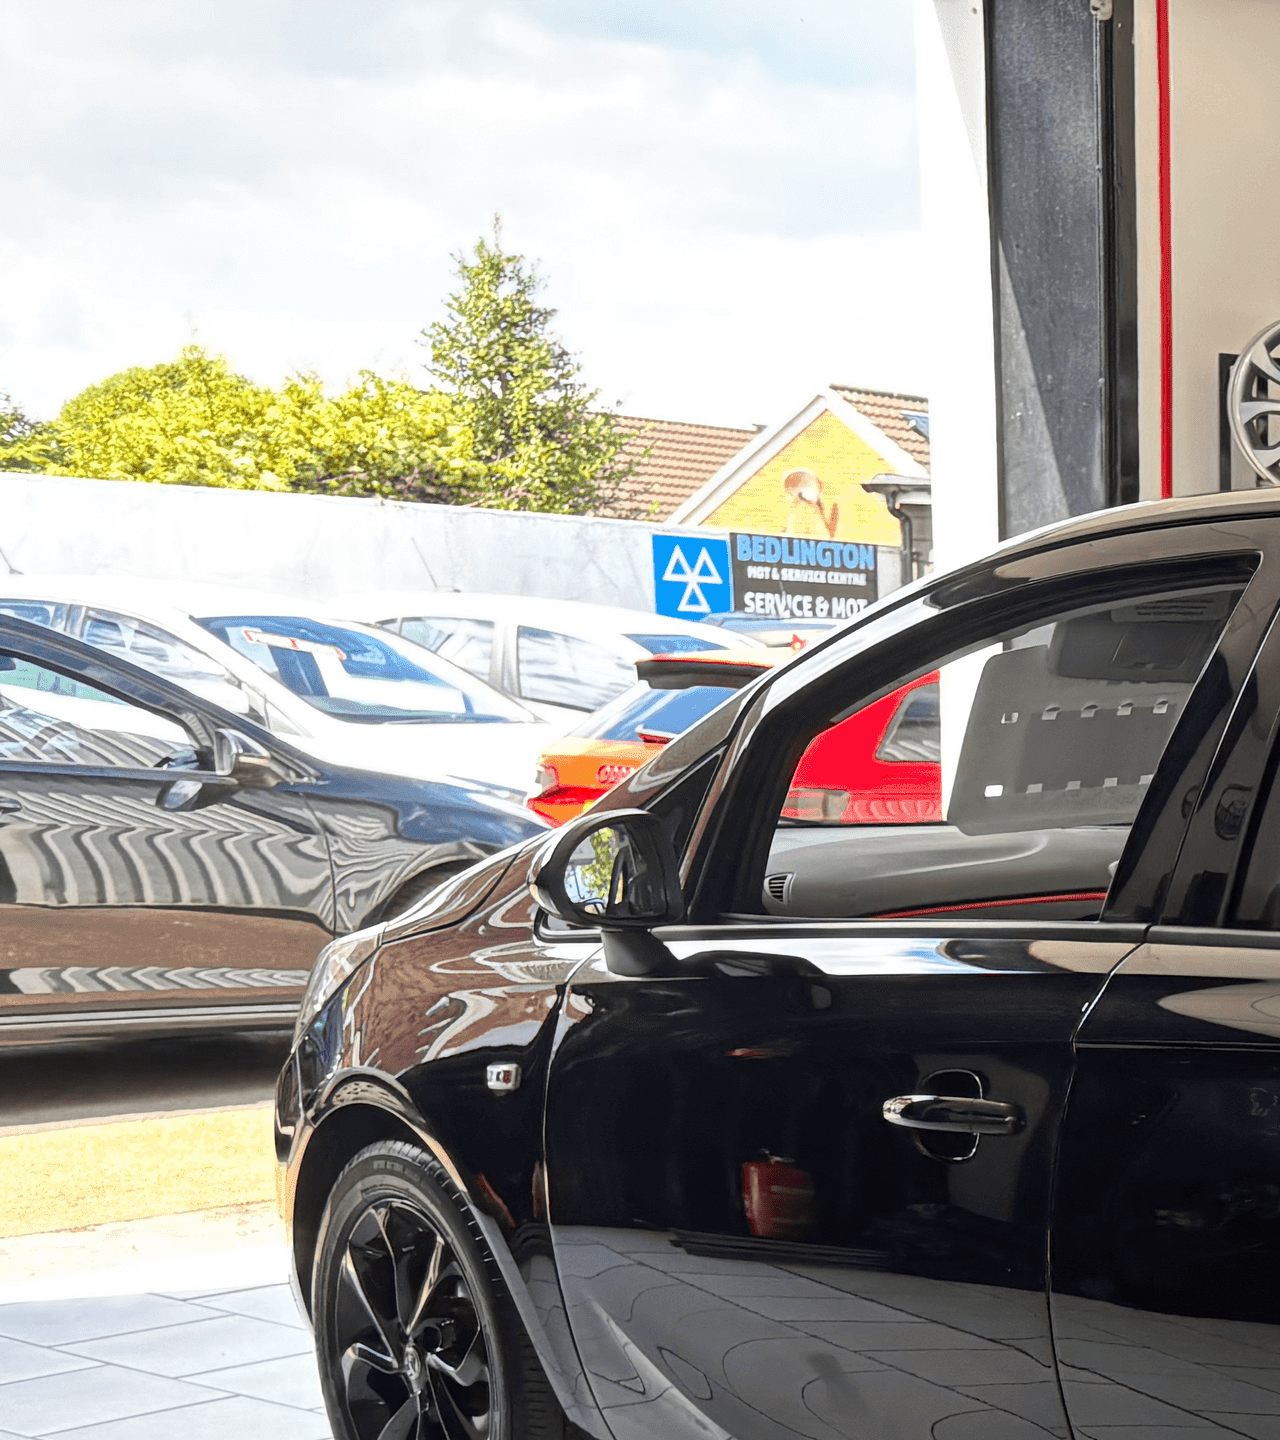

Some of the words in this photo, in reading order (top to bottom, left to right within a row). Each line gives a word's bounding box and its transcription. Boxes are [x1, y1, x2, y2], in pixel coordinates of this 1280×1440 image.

[737, 534, 874, 570] BEDLINGTON
[747, 566, 771, 580] MOT
[781, 568, 827, 583] SERVICE
[827, 571, 867, 586] CENTRE
[744, 591, 813, 618] SERVICE
[815, 596, 829, 617] &
[831, 597, 868, 618] MOT
